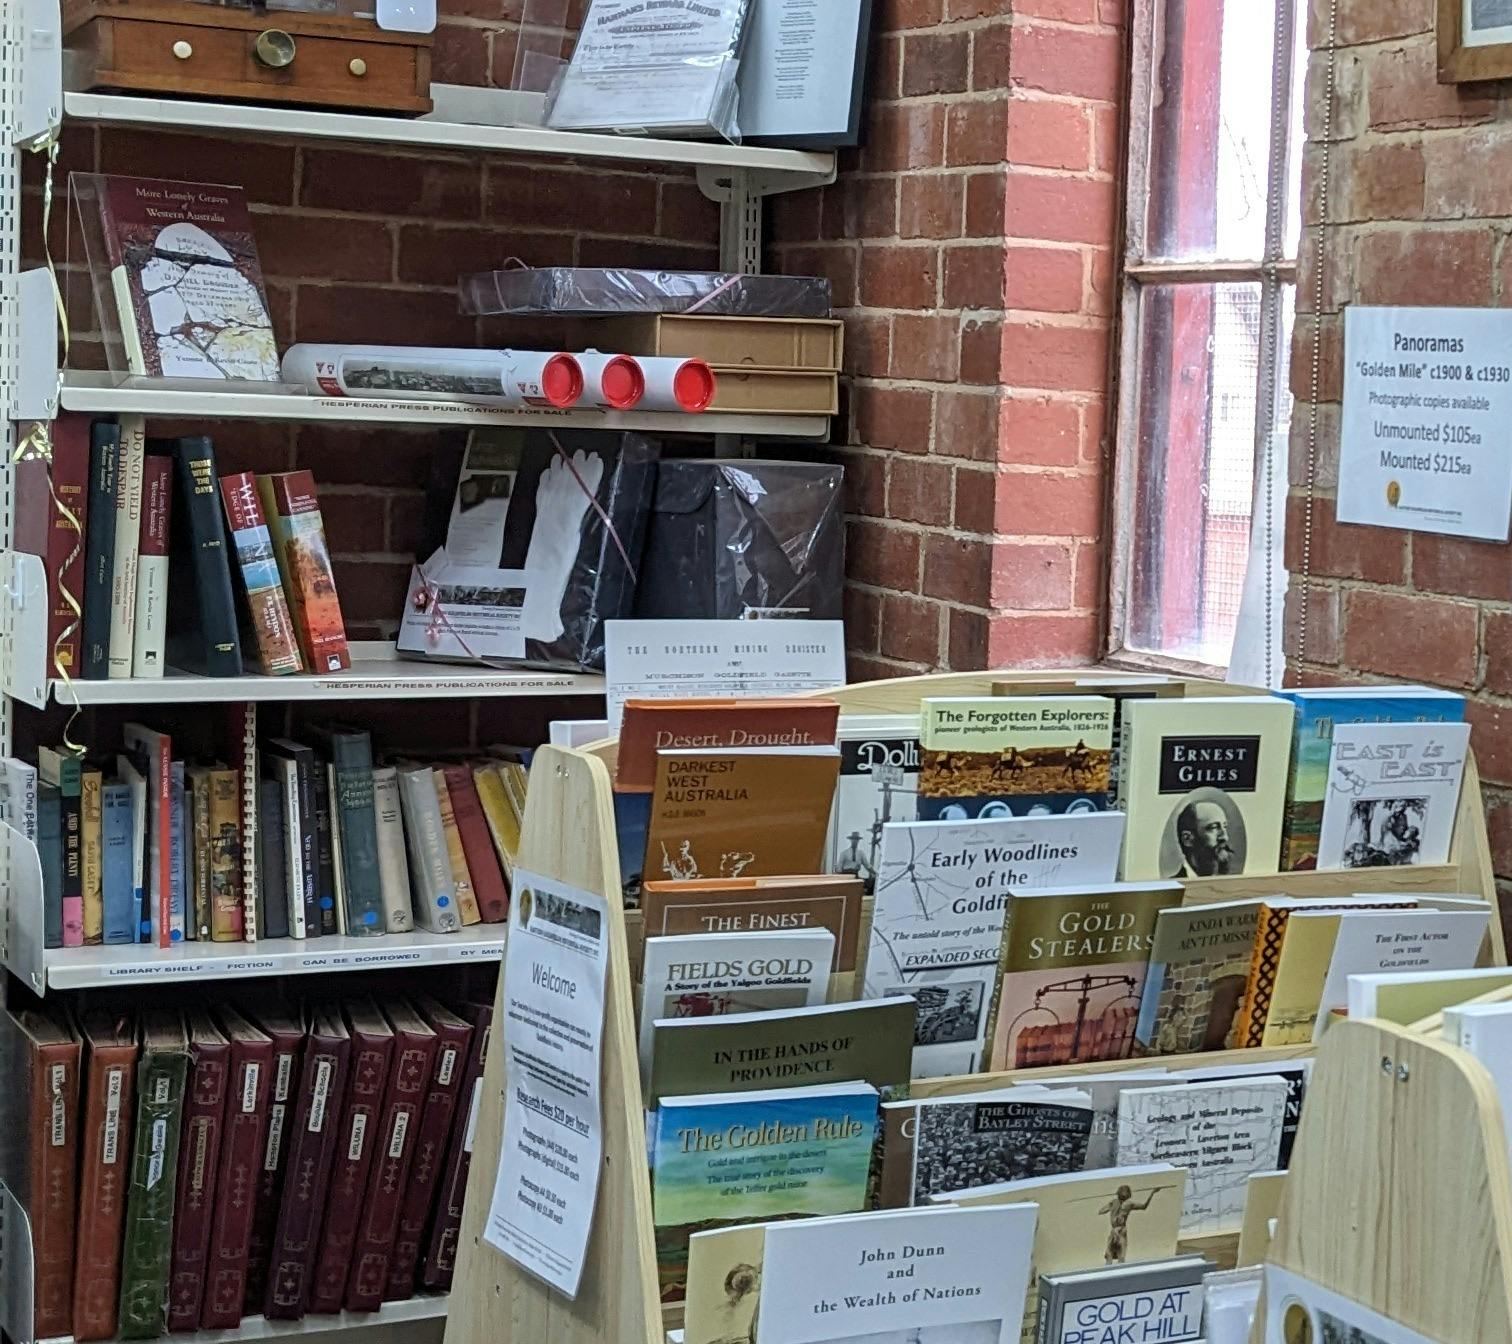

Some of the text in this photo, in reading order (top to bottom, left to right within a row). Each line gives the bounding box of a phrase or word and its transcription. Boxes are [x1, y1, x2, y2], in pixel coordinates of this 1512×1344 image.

[136, 188, 228, 203] More Lonely Graves
[147, 208, 225, 223] Western Australia
[1394, 332, 1464, 353] Panoramas
[1430, 367, 1461, 380] c1900
[1466, 368, 1473, 380] &
[1478, 368, 1510, 382] c1930
[1369, 392, 1490, 410] Photographic copies available
[1374, 420, 1480, 445] Unmounted $105ea
[1380, 451, 1471, 475] Mounted $215ea
[117, 439, 128, 509] TO DESPAIR
[130, 429, 144, 520] DO NOT YIELD
[936, 709, 1109, 724] The Forgotten Explorers:
[1172, 745, 1247, 762] ERNEST
[668, 760, 736, 773] DARKEST
[1178, 766, 1238, 782] GILES
[667, 775, 708, 787] WEST
[664, 789, 749, 802] AUSTRALIA
[932, 844, 1078, 868] Early Woodlines
[1060, 912, 1136, 933] GOLD
[1030, 934, 1155, 958] STEALERS
[109, 965, 202, 975] LIBRARY SHELF
[227, 961, 273, 970] FICTION
[303, 958, 328, 966] CAN
[355, 953, 421, 963] BORROWED
[667, 958, 813, 981] FIELDS GOLD
[532, 961, 577, 1000] Welcome
[713, 1037, 854, 1064] IN THE HANDS OF
[730, 1058, 835, 1083] PROVIDENCE
[678, 1115, 862, 1154] The Golden Rule
[859, 1244, 945, 1265] John Dunn
[887, 1265, 914, 1278] and
[814, 1285, 981, 1314] the Wealth of Nations
[1077, 1291, 1190, 1327] GOLD AT
[1143, 1314, 1198, 1342] HILL
